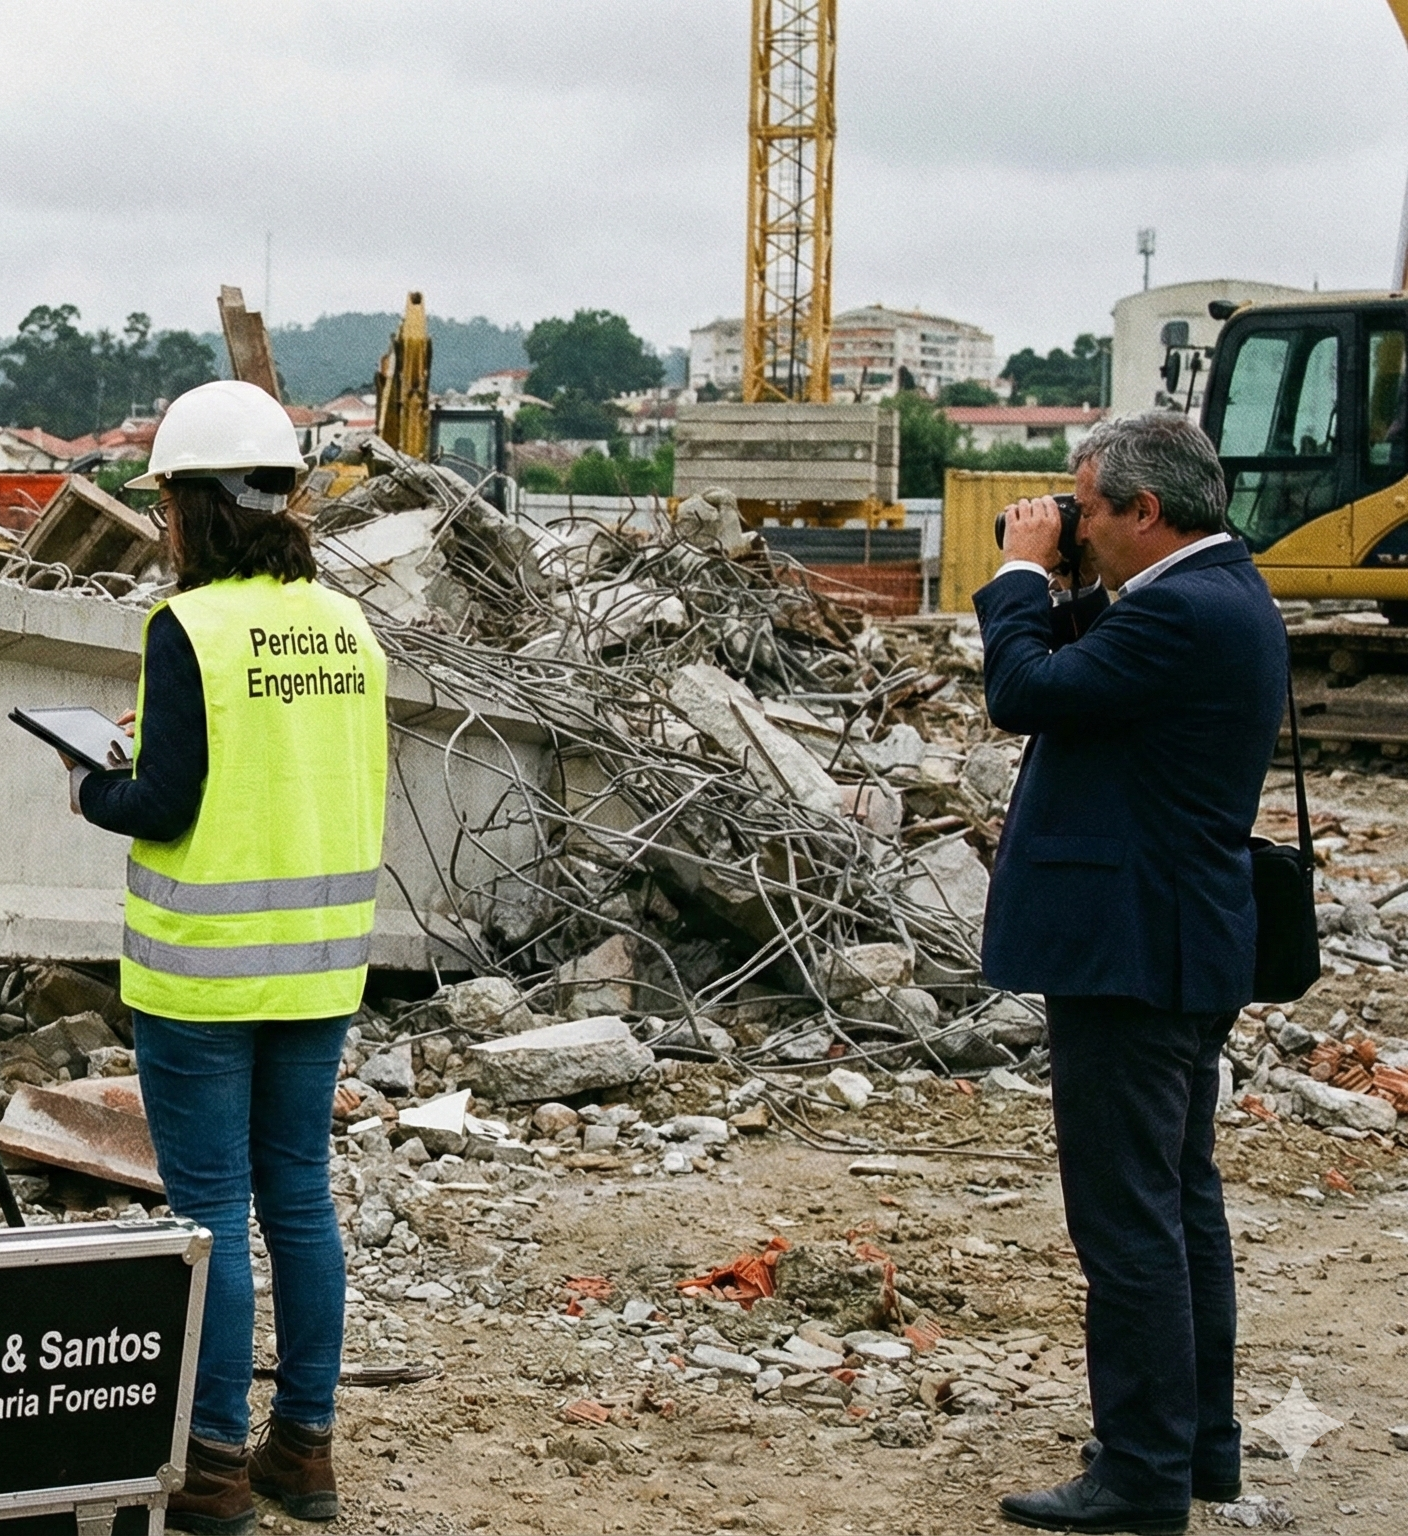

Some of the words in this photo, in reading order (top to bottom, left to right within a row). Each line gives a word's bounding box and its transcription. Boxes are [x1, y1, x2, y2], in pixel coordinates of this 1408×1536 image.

[249, 626, 328, 657] Perícia
[335, 626, 357, 654] de
[247, 665, 365, 704] Engenharia
[1, 1334, 26, 1373] &
[39, 1326, 161, 1370] Santos
[48, 1382, 156, 1414] Forense
